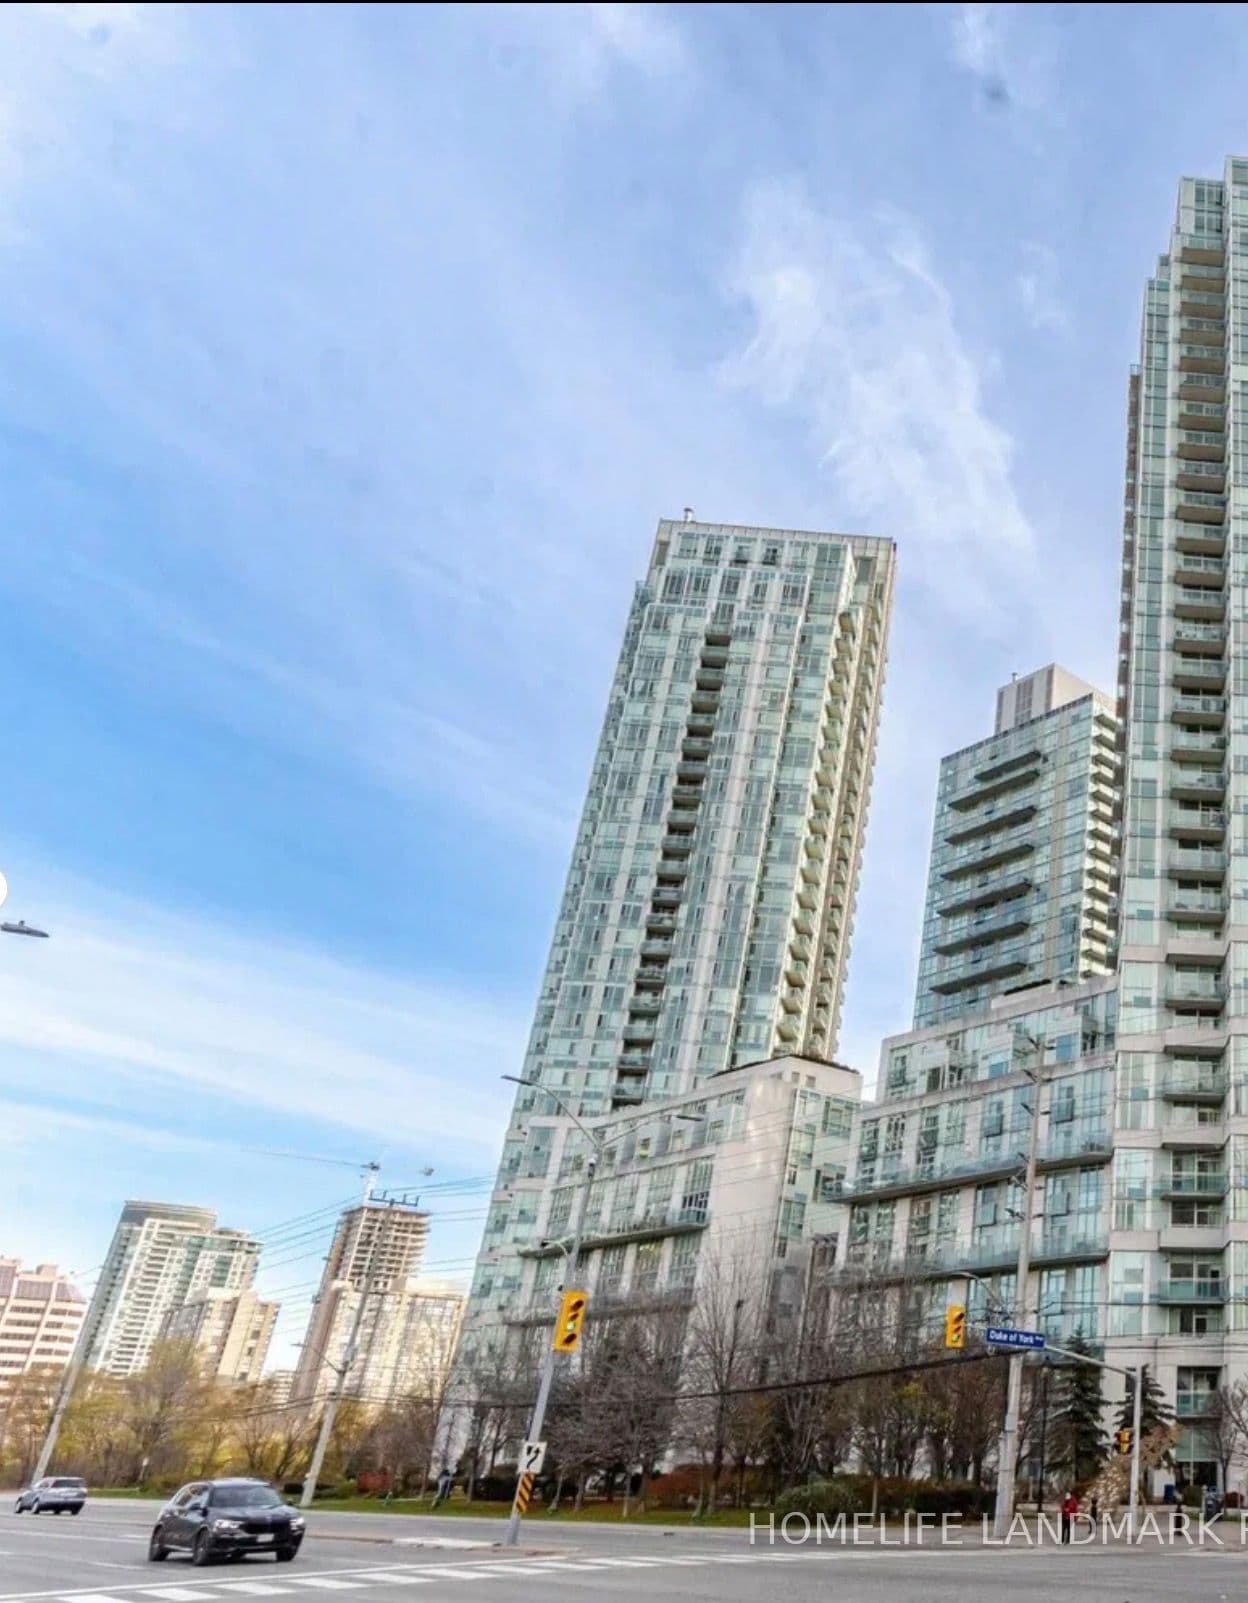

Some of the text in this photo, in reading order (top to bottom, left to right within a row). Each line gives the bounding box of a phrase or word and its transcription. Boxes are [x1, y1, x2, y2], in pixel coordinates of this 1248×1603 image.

[989, 1330, 1008, 1341] Duke
[1009, 1333, 1018, 1342] of
[1019, 1334, 1034, 1345] York
